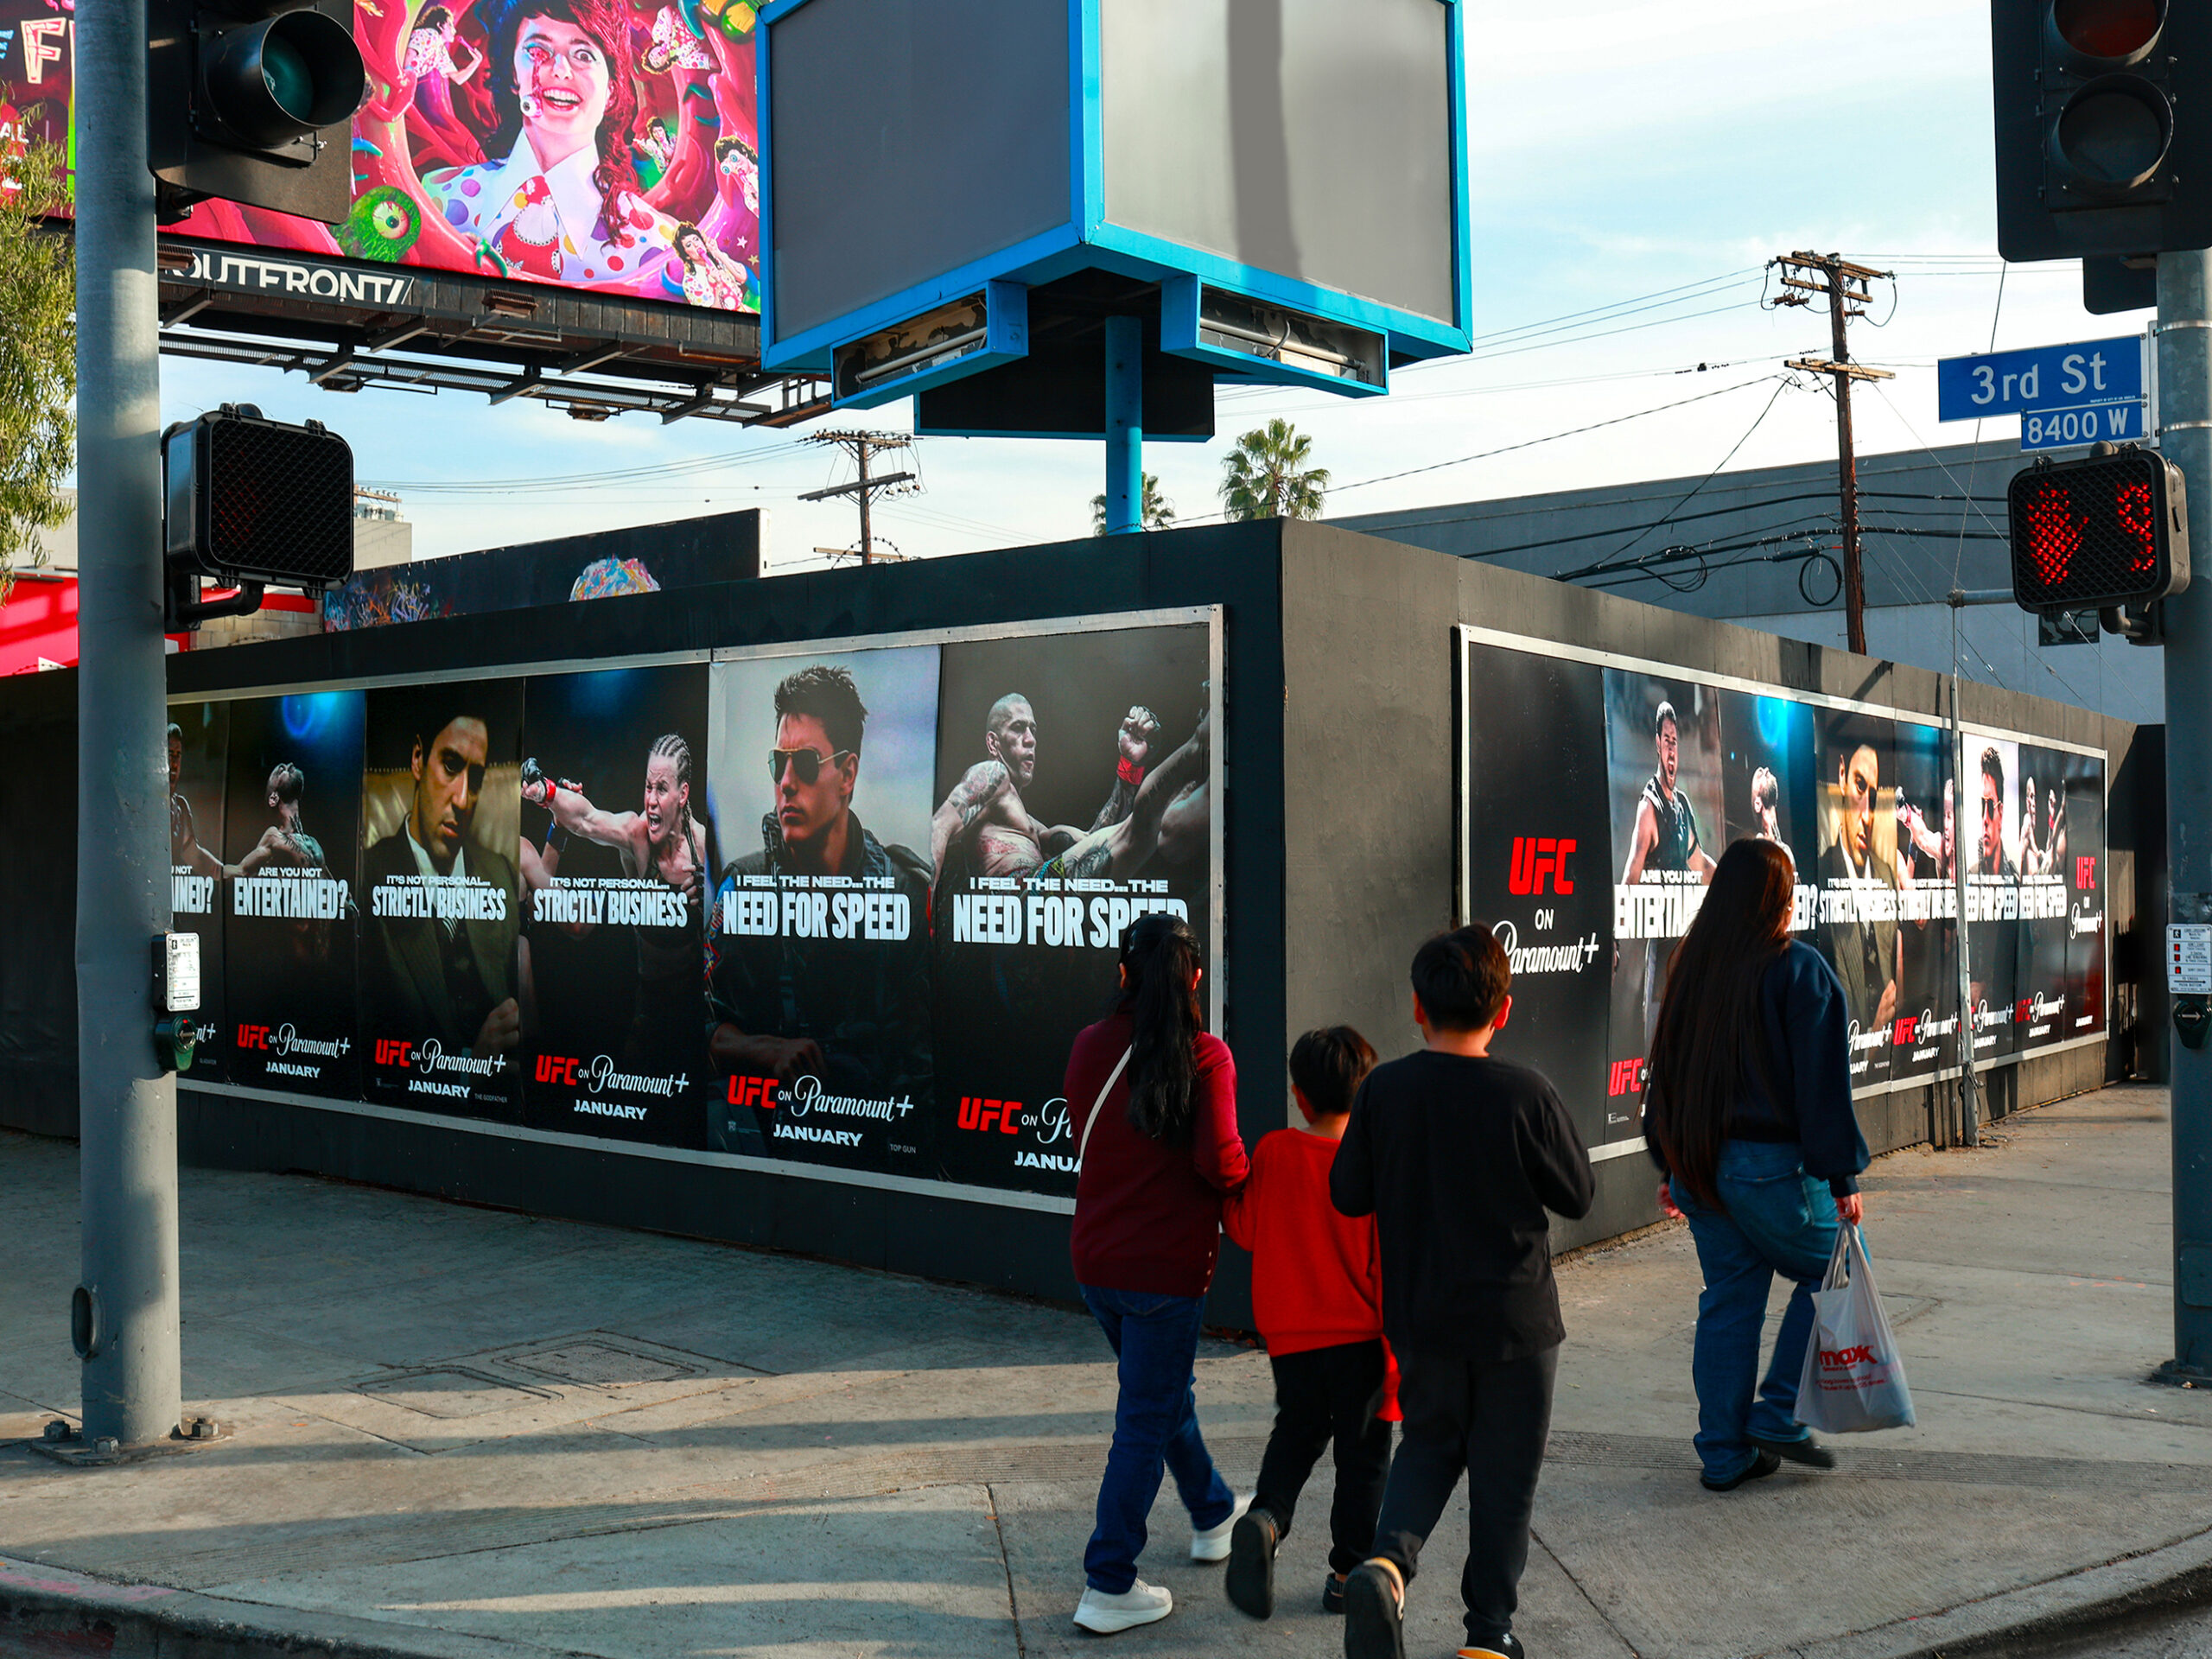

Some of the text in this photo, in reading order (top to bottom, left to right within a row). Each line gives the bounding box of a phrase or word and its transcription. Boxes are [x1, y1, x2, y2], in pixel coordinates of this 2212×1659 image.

[1971, 351, 2107, 405] 3rd St
[2027, 408, 2128, 444] 8400 W
[175, 865, 193, 874] NOT
[258, 868, 322, 878] ARE YOU NOT
[386, 875, 404, 885] IT'S
[406, 875, 426, 886] NOT
[736, 875, 741, 887] I
[743, 875, 777, 887] FEEL
[779, 875, 810, 887] THE
[1508, 836, 1577, 895] UFC
[1662, 870, 1682, 883] YOU
[1683, 870, 1703, 883] NOT
[2076, 856, 2096, 890] UFC
[234, 877, 349, 920] ENTERTAINED?
[550, 877, 670, 889] IT'S NOT PERSONAL...
[969, 877, 976, 889] I
[978, 877, 1020, 891] FEEL
[1022, 878, 1061, 891] THE
[372, 885, 506, 921] STRICTLY BUSINESS
[533, 888, 688, 928] STRICTLY BUSINESS
[722, 891, 911, 941] NEED FOR SPEED
[1535, 908, 1554, 931] ON
[953, 893, 1022, 944] NEED
[1027, 895, 1085, 948] FOR
[1492, 920, 1599, 975] Paramount+
[237, 1024, 270, 1050] UFC
[268, 1034, 277, 1044] ON
[276, 1022, 351, 1058] Paramount+
[1893, 1016, 1917, 1046] UFC
[265, 1061, 321, 1078] JANUARY
[374, 1038, 506, 1077] UFC ON Paramount+
[408, 1079, 471, 1099] JANUARY
[535, 1054, 690, 1097] UFC ON Paramount+
[1608, 1058, 1644, 1096] UFC
[574, 1099, 647, 1121] JANUARY
[727, 1074, 914, 1122] UFC ON Paramount+
[957, 1096, 1023, 1135] UFC
[1021, 1114, 1038, 1127] ON
[772, 1123, 863, 1147] JANUARY
[902, 1144, 917, 1154] GUN
[1014, 1151, 1080, 1173] JANU
